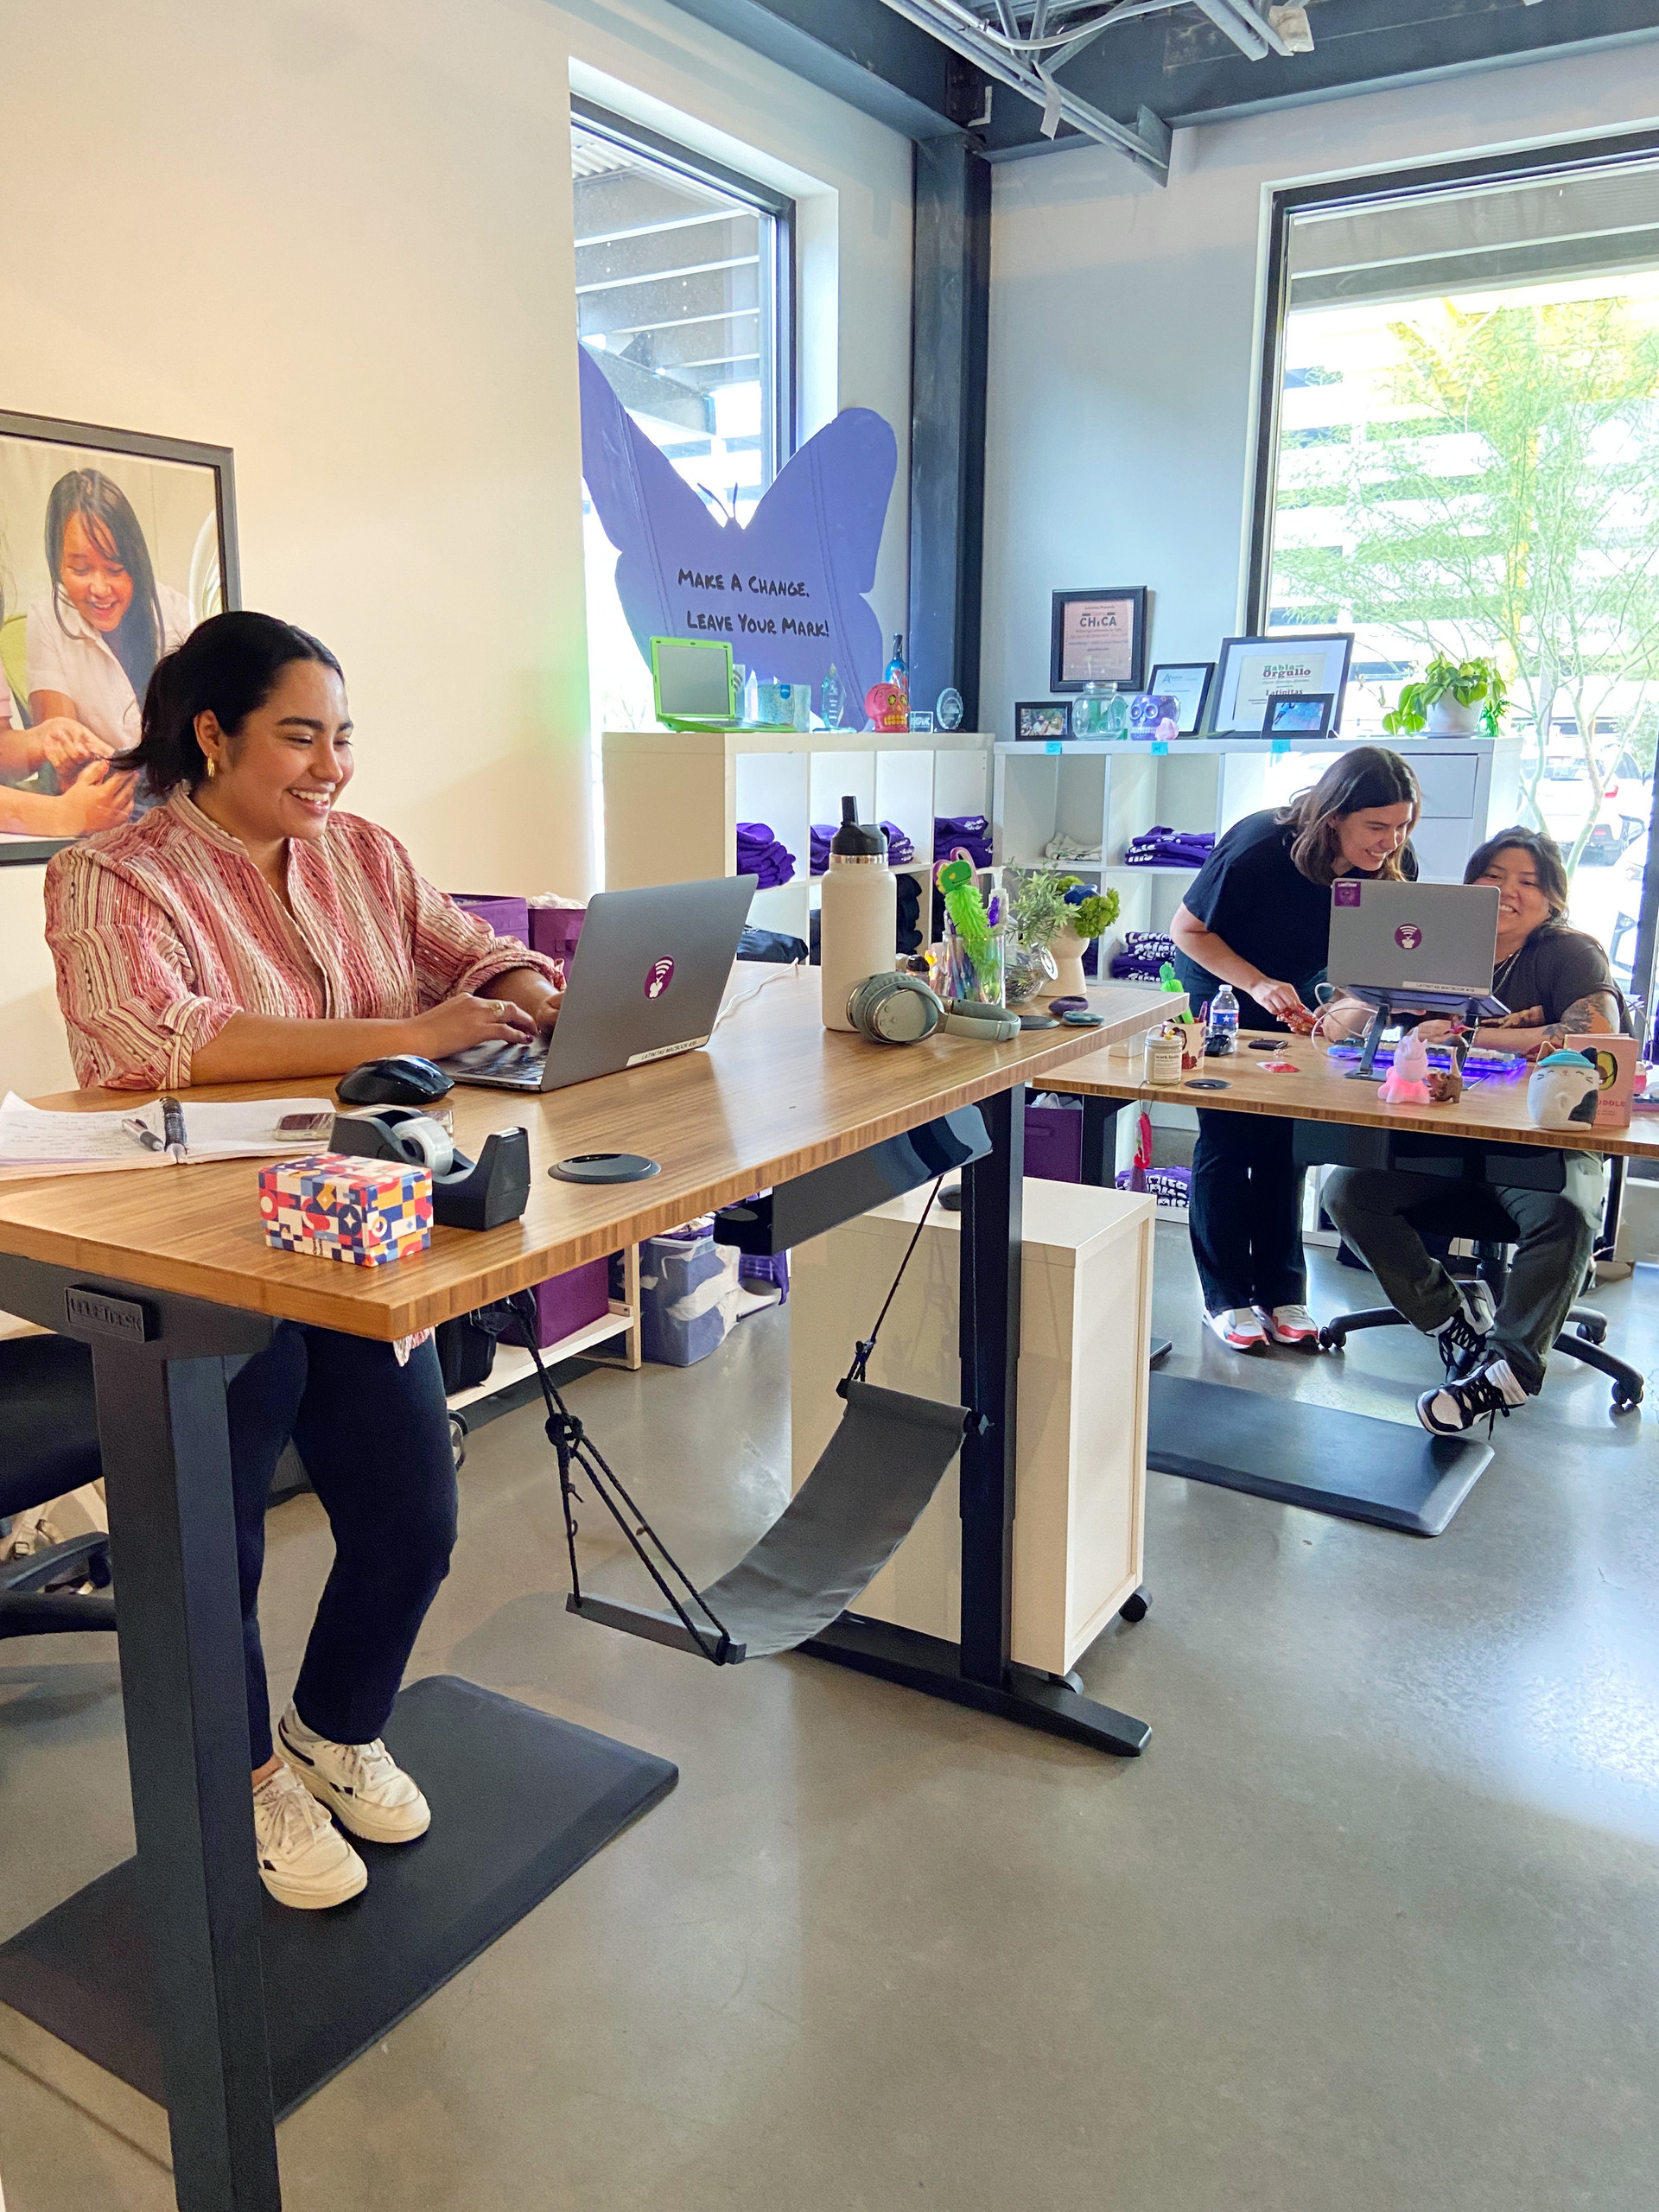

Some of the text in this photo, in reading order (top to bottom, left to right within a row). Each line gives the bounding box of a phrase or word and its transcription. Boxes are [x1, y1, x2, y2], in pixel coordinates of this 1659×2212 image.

[678, 569, 725, 590] MAKE
[731, 573, 742, 592] A
[687, 610, 830, 638] LEAVE YOUR MARK!
[1262, 668, 1312, 679] Orgullo
[1264, 664, 1295, 672] Habla
